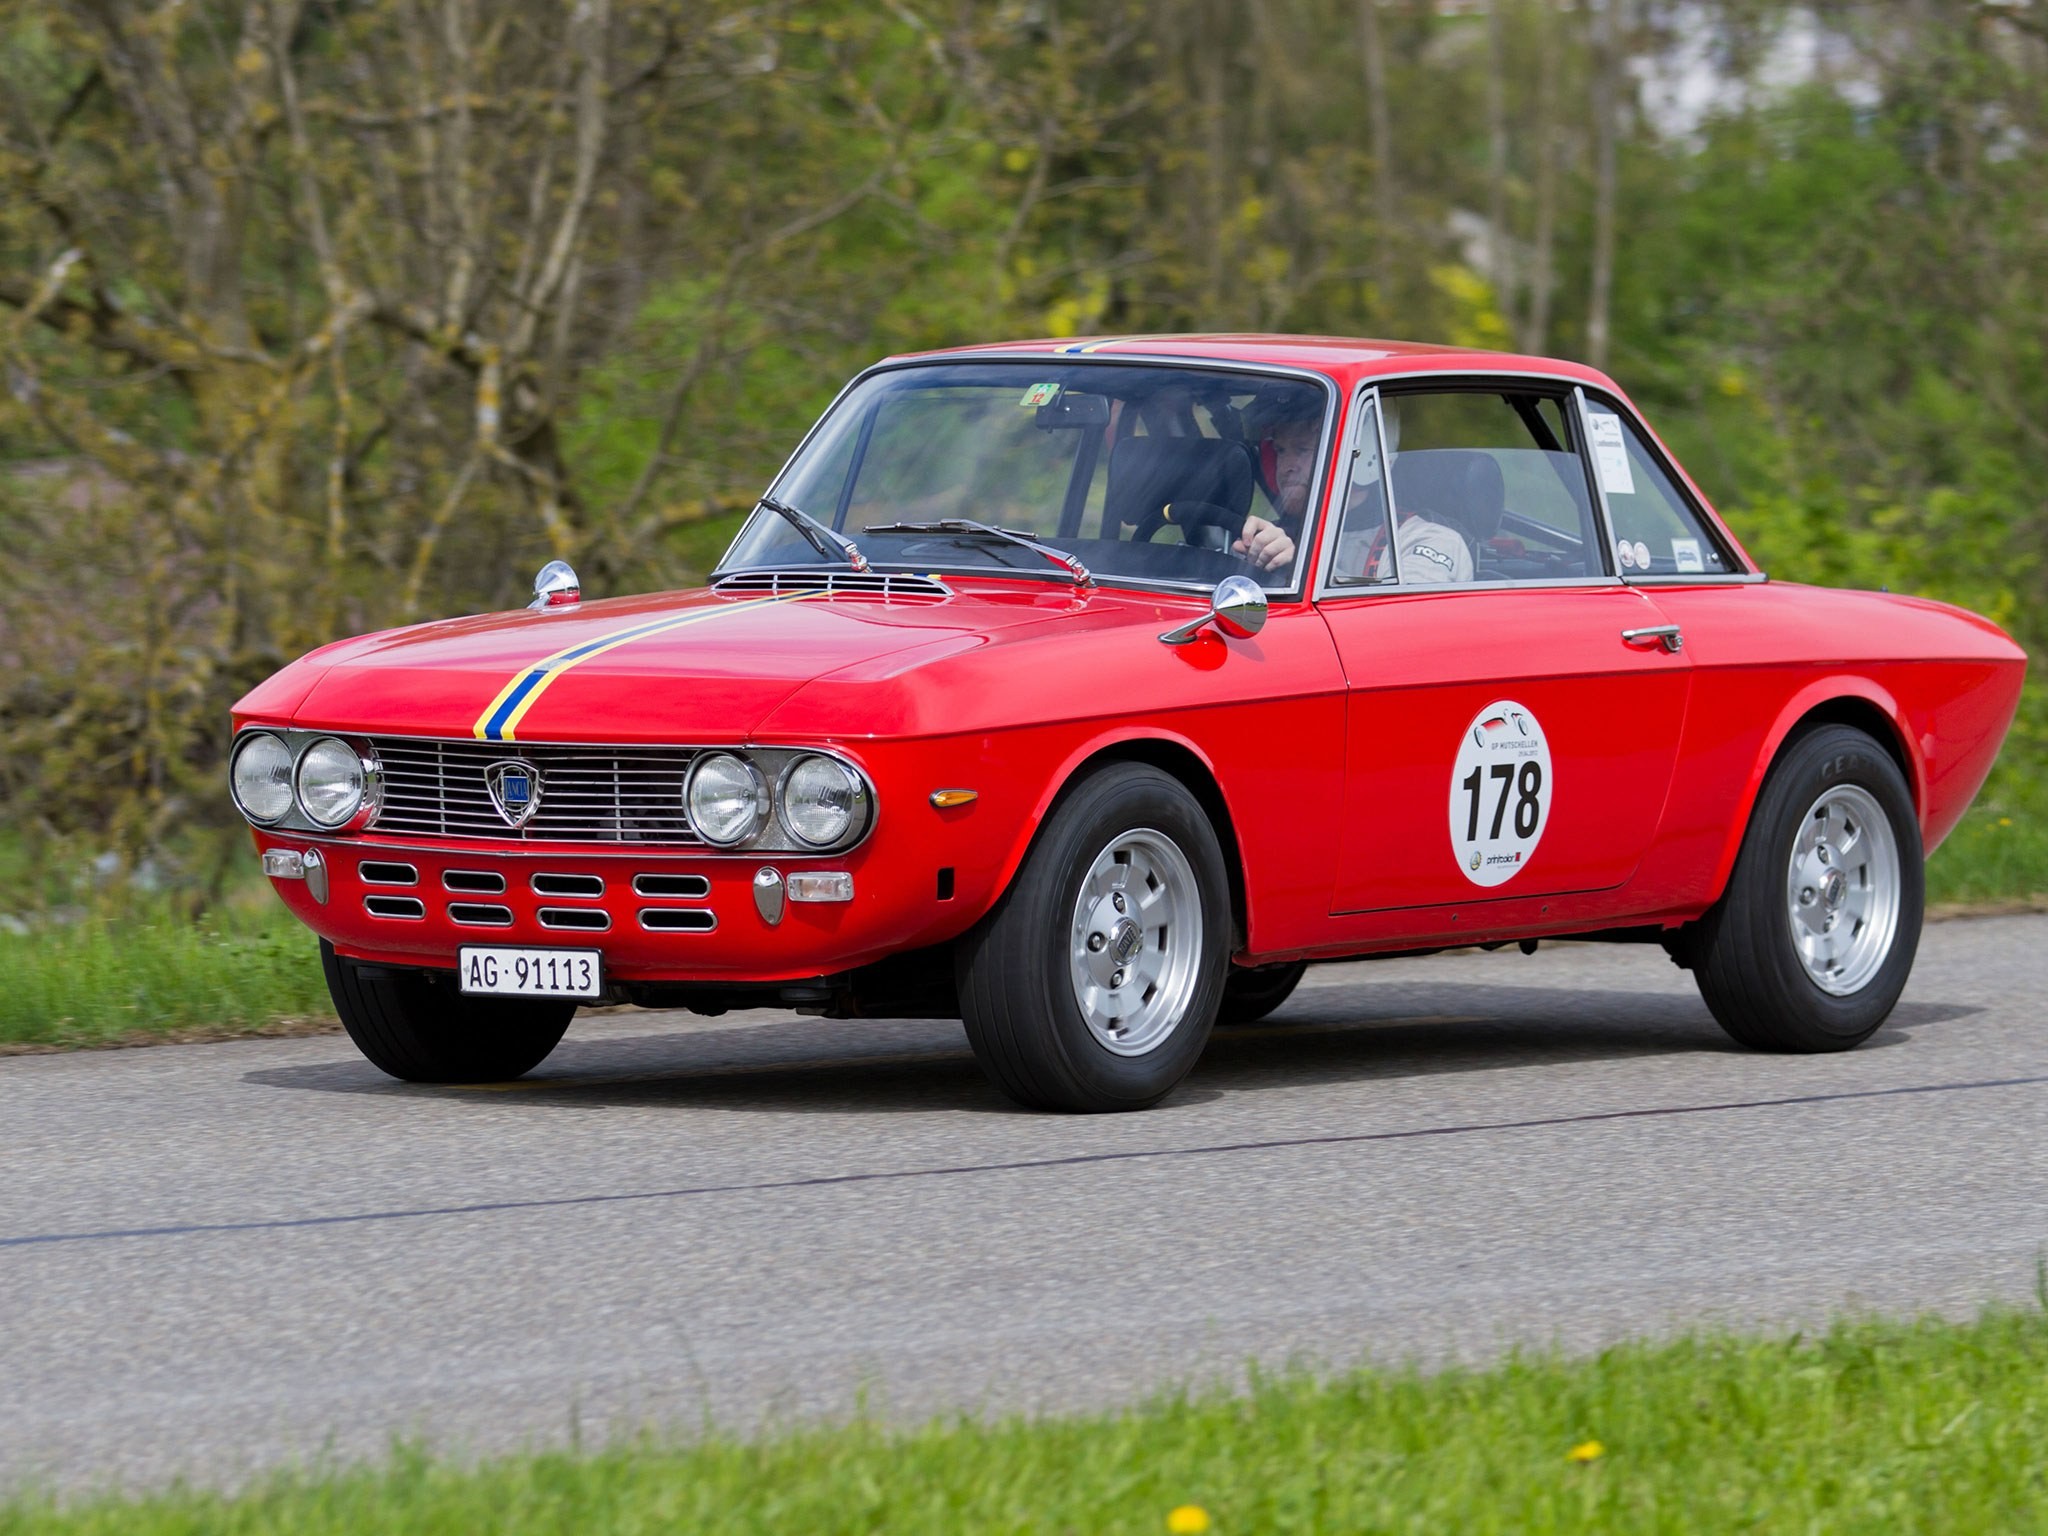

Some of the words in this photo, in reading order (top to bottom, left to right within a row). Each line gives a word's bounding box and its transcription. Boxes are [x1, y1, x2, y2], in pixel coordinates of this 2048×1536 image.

[1032, 393, 1045, 403] 12
[505, 778, 528, 801] LANCIA
[1463, 760, 1542, 842] 178
